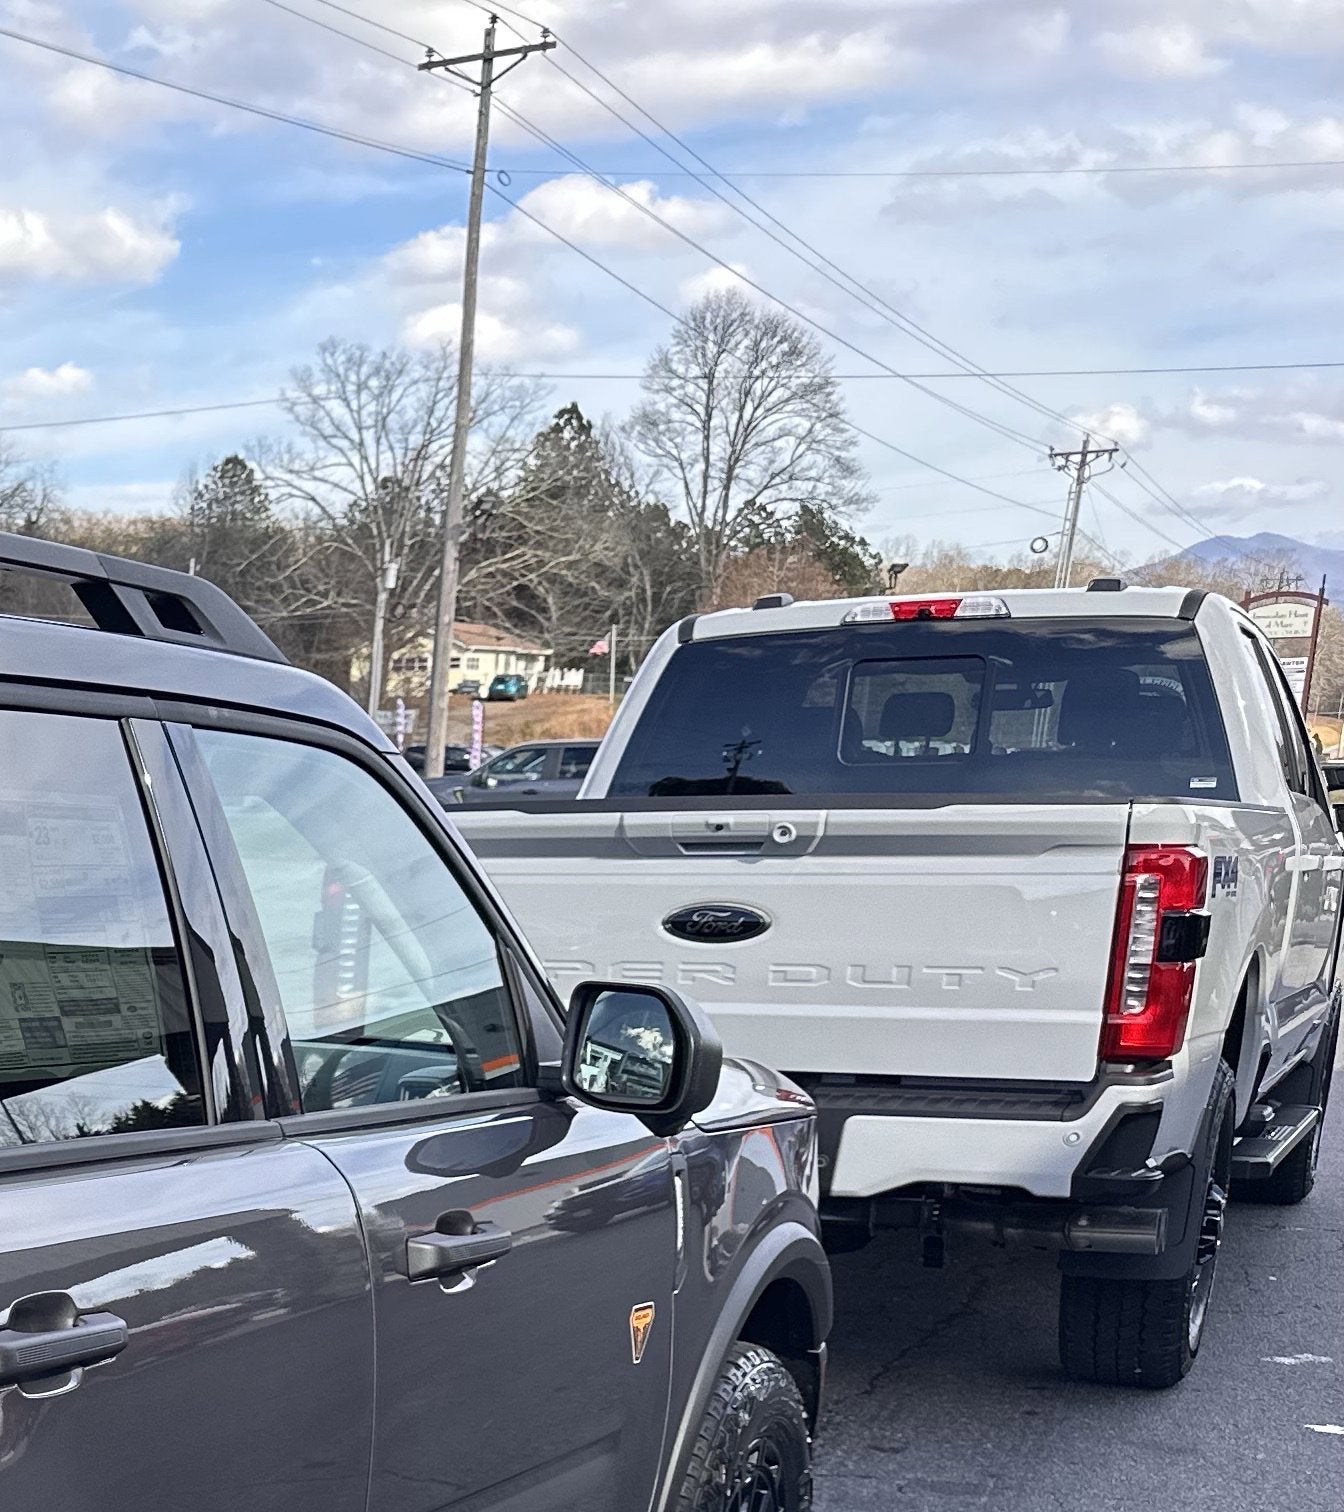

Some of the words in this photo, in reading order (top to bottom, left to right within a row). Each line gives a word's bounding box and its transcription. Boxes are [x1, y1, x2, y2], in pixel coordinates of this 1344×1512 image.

[1211, 855, 1239, 898] FX4
[686, 910, 745, 934] Ford
[768, 962, 1059, 992] DUTY
